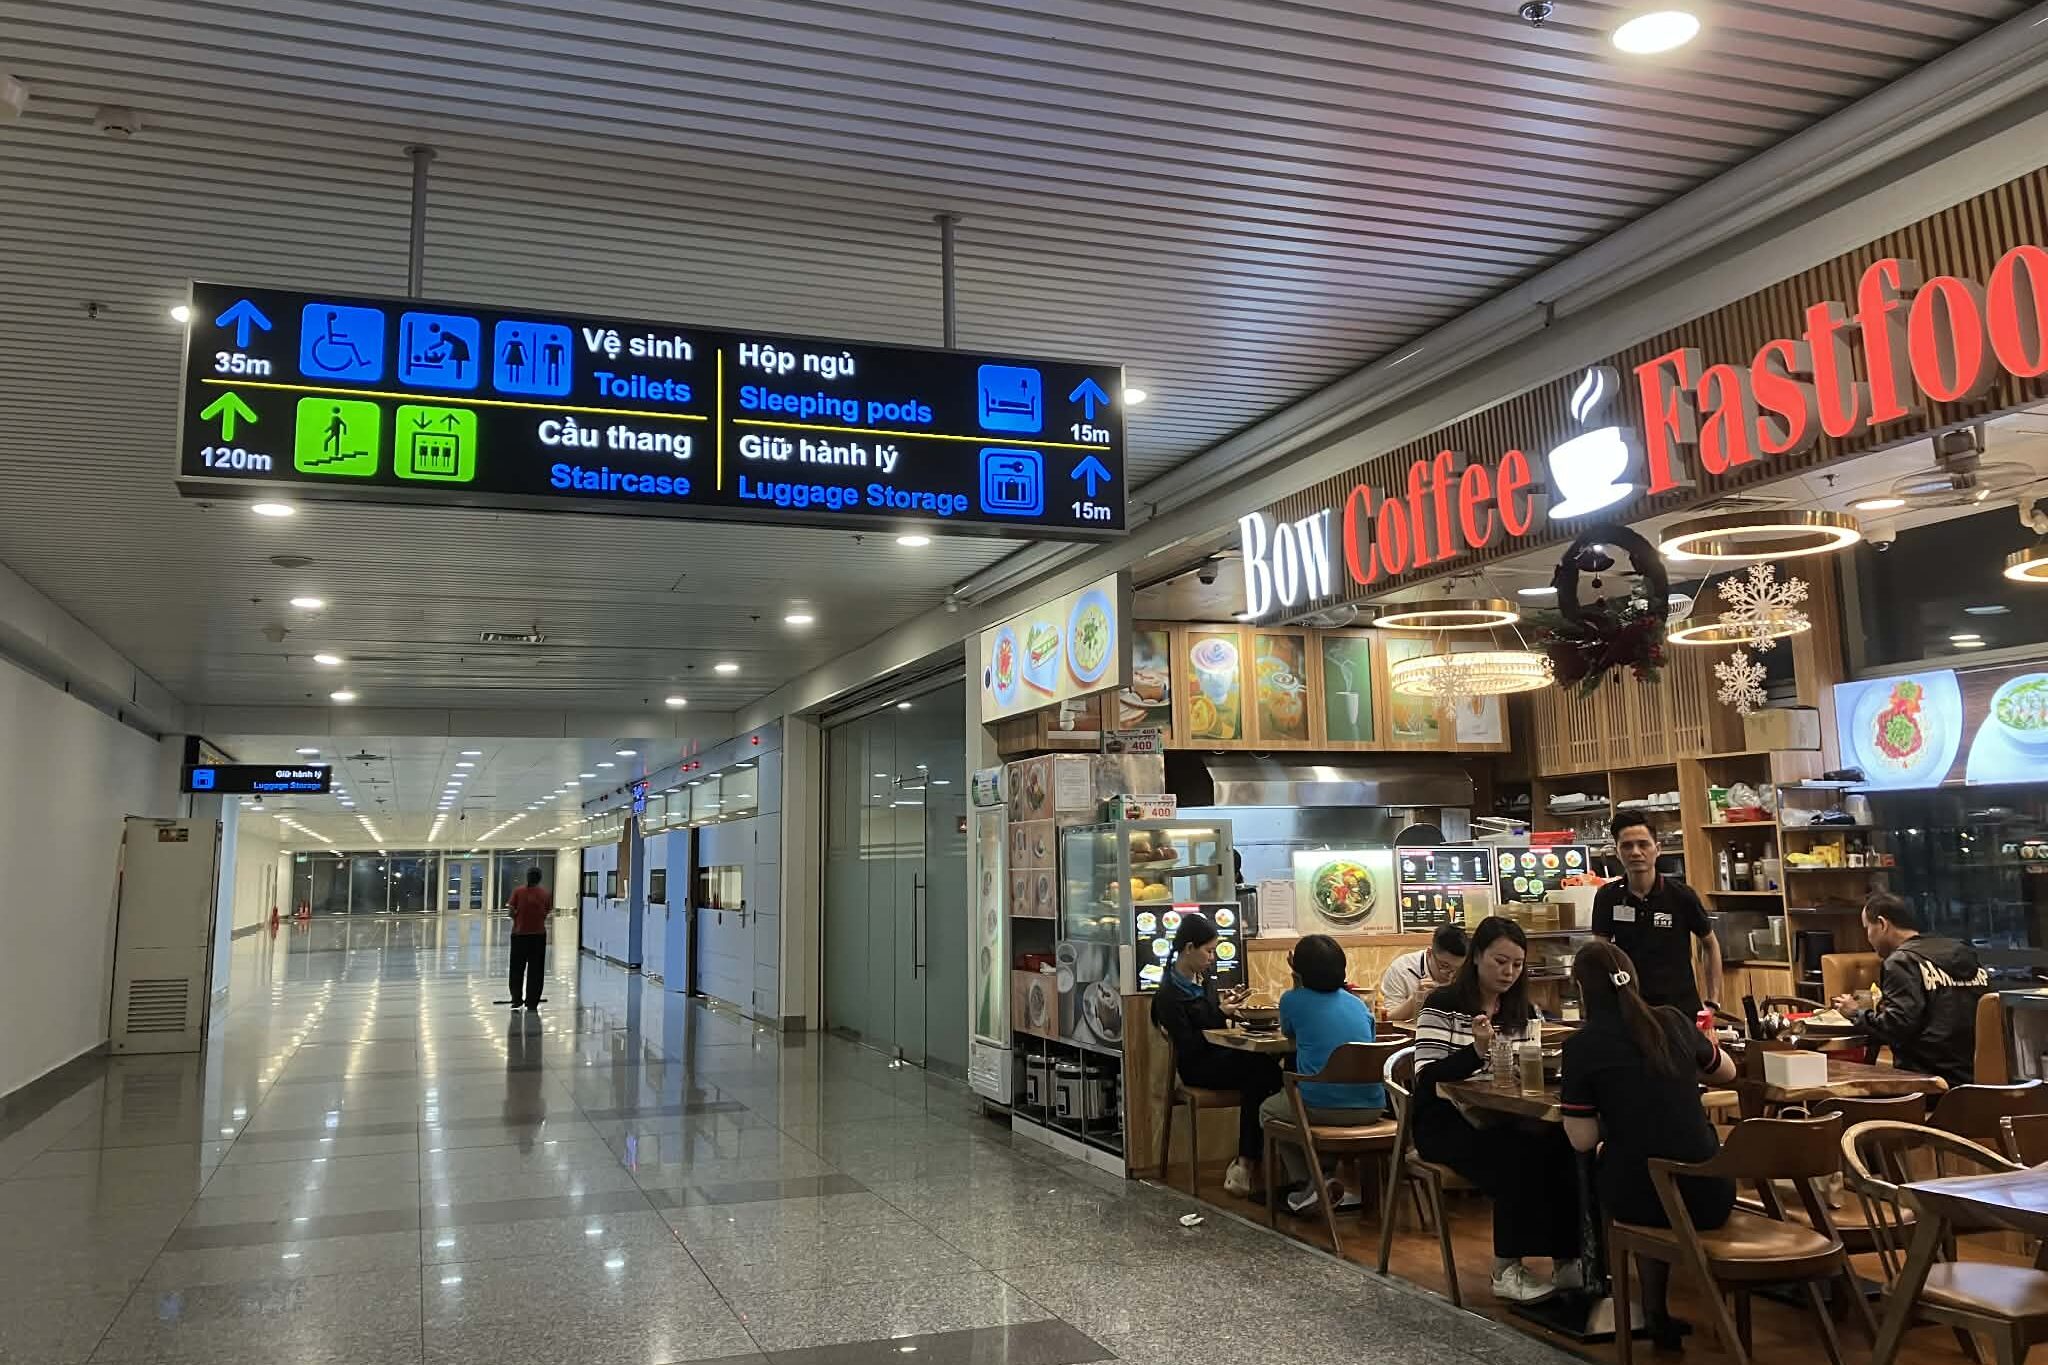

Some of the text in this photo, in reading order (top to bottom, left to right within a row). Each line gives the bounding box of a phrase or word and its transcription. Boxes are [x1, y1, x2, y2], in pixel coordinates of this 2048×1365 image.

[583, 328, 692, 361] Vệ sinh
[739, 343, 855, 379] Hộp ngủ
[214, 352, 271, 376] 35m
[594, 371, 692, 402] Toilets
[739, 385, 933, 425] Sleeping pods
[1343, 449, 1533, 585] Coffee
[1633, 244, 2048, 496] Fastfoo
[538, 415, 692, 459] Cầu thang
[1070, 423, 1110, 444] 15m
[201, 446, 272, 471] 120m
[739, 434, 899, 474] Giữ hành lý
[550, 463, 691, 497] Staircase
[739, 474, 969, 516] Luggage Storage
[1071, 501, 1111, 521] 15m
[1132, 741, 1152, 750] 400
[1151, 808, 1171, 817] 400
